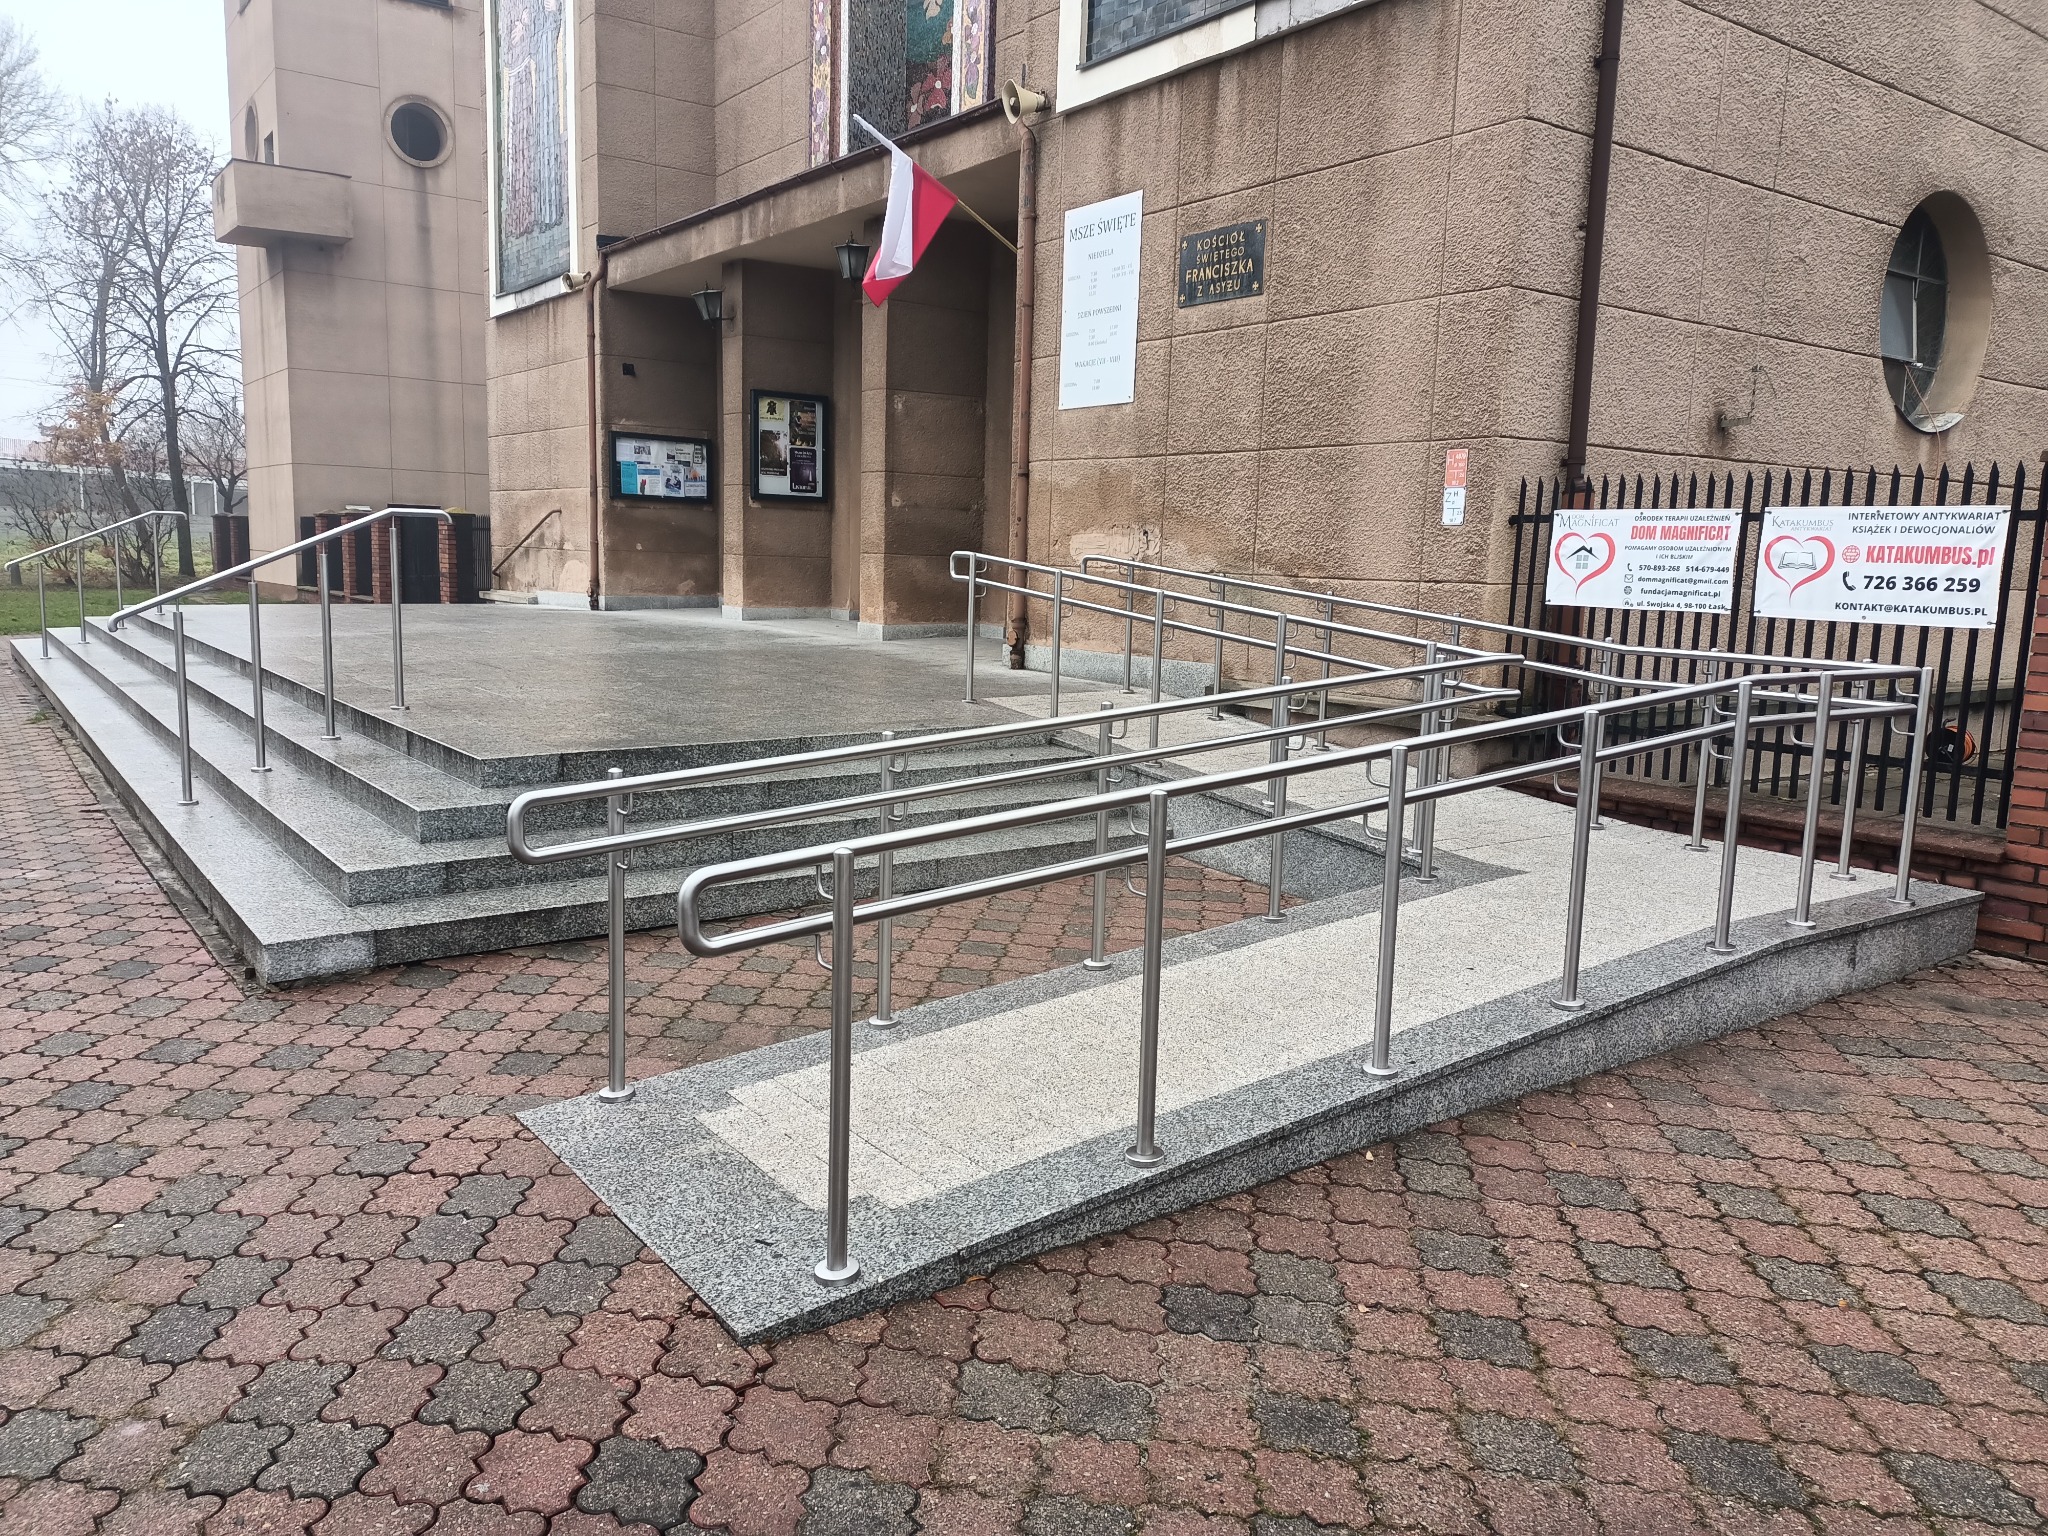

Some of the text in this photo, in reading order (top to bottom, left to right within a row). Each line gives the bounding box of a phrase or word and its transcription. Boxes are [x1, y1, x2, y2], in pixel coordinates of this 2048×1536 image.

[1069, 212, 1137, 242] MSZE ŚWIĘTE
[1196, 230, 1245, 251] KOŚCIÓŁ
[1185, 258, 1253, 283] FRANCISZKA
[1197, 278, 1241, 297] Z ASYŻU
[1559, 513, 1619, 530] MAGNIFICAT
[1772, 516, 1834, 528] KATAKUMBUS
[1848, 511, 2001, 521] INTERNETOWY ANTYKWARIAT
[1630, 525, 1731, 540] DOM MAGNIFICAT
[1852, 523, 1996, 535] KSIĄŻEK I DEWOCJONALIÓW
[1865, 545, 1996, 568] KATAKUMBUS.pl
[1685, 565, 1730, 573] 514-679-449
[1637, 576, 1729, 585] dommagnificat@gmail.com
[1863, 575, 1981, 593] 726 366 259
[1640, 588, 1721, 598] fundacjamagnificat.pl
[1835, 602, 1988, 616] KONTAKT@KATAKUMBUS.PL
